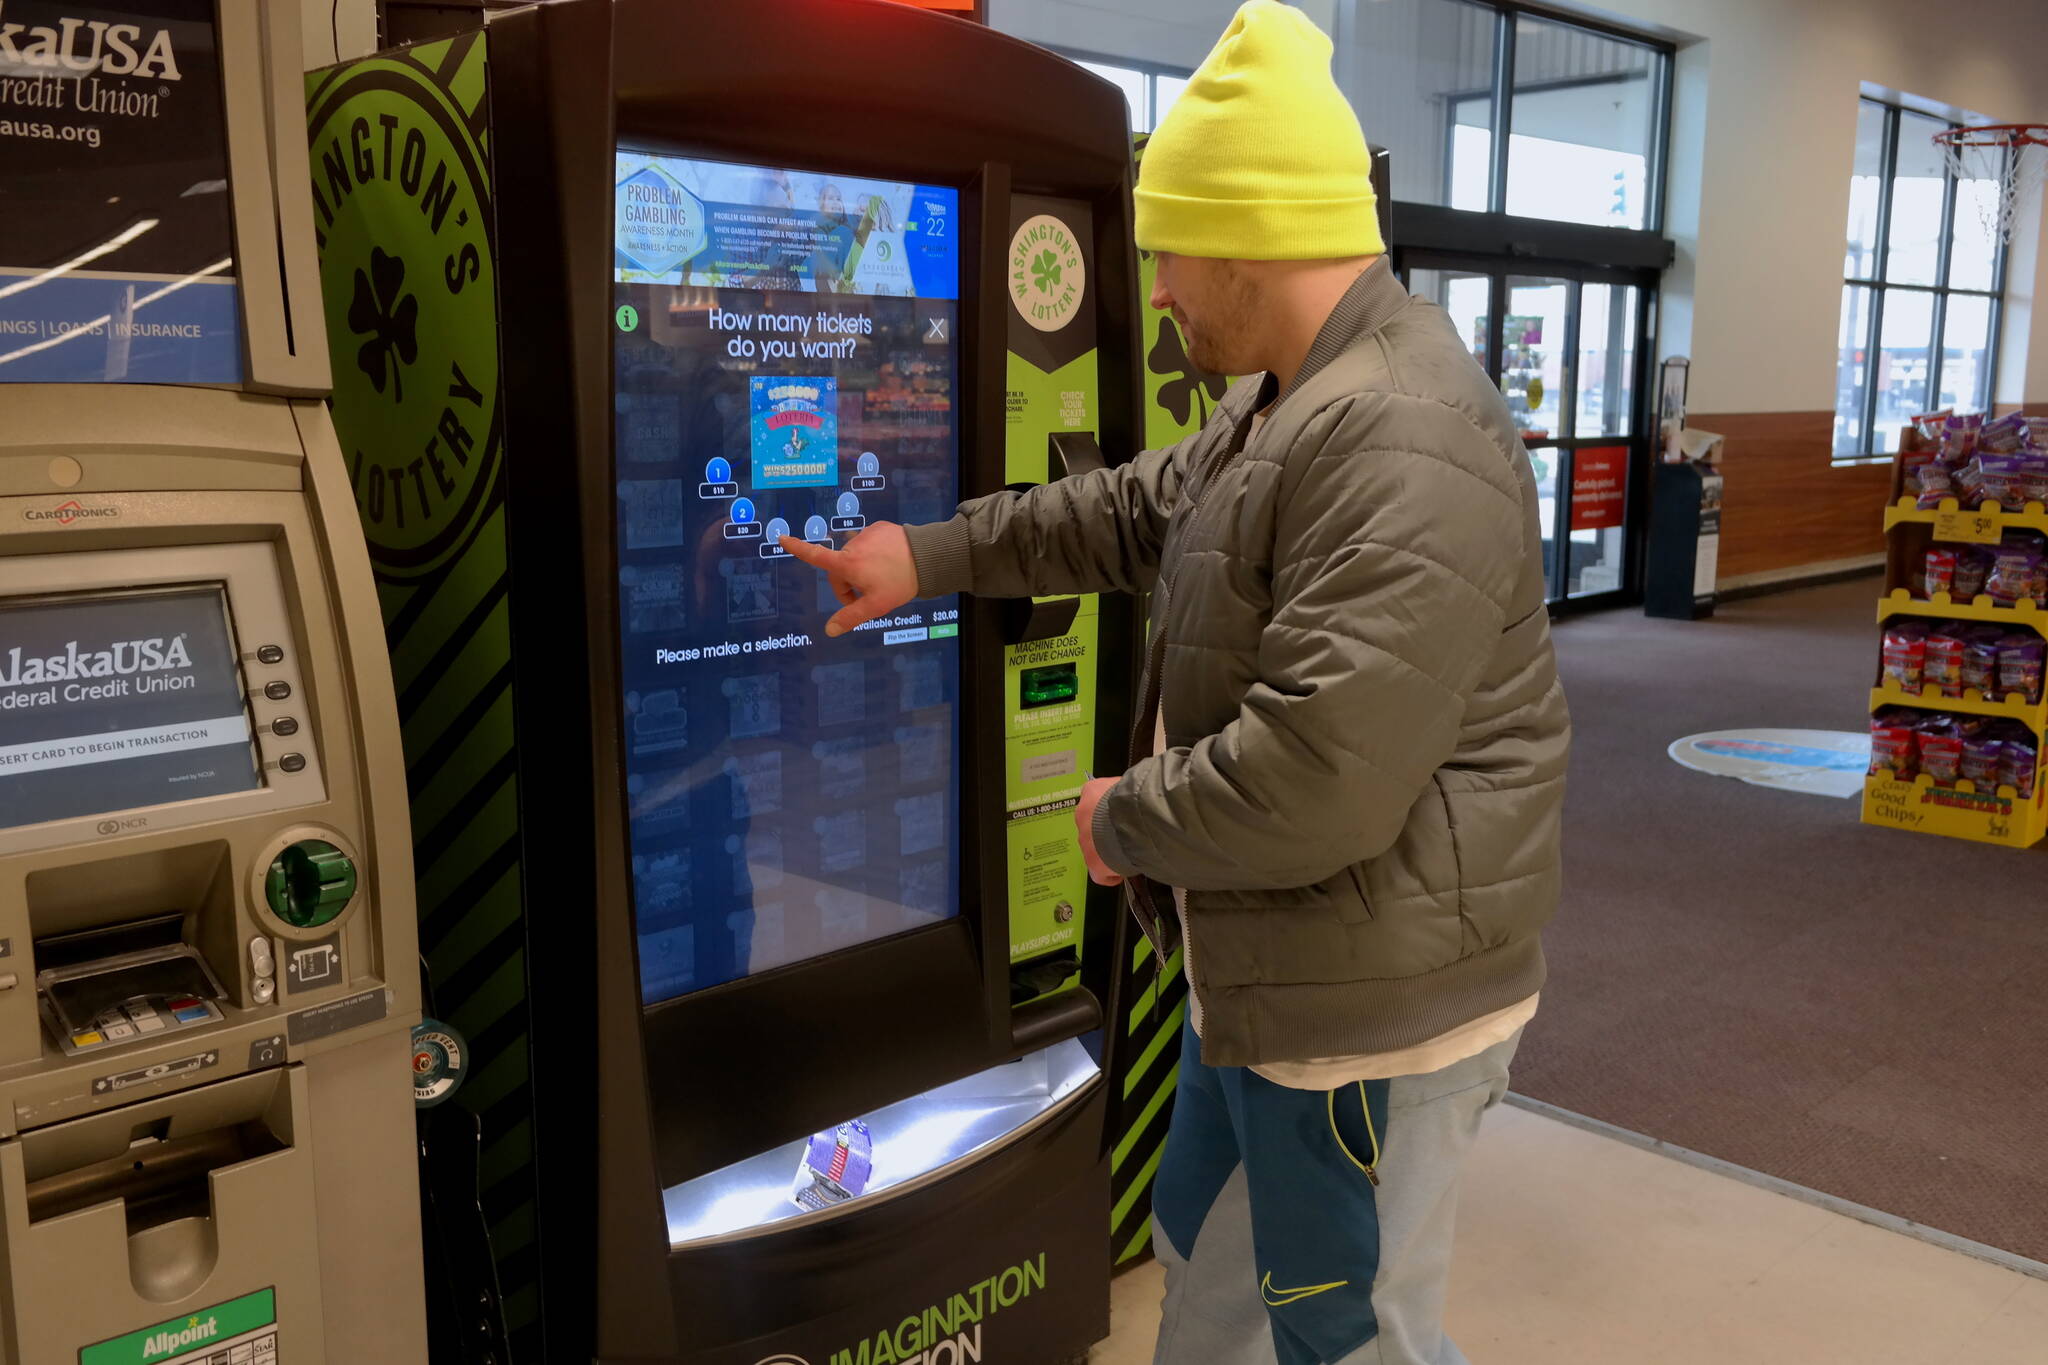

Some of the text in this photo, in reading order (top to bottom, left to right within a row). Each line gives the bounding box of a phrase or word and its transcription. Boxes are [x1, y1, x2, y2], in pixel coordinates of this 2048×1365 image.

[627, 184, 682, 206] PROBLEM
[312, 113, 480, 295] INGTON'S
[625, 205, 686, 225] GAMBLING
[621, 225, 694, 238] AWARENESS MONTH
[926, 217, 945, 237] 22
[1013, 224, 1077, 298] WASHINGTON'S
[1031, 283, 1077, 320] LOTTERY
[49, 321, 104, 338] LOANS
[115, 322, 202, 338] INSURANCE
[709, 308, 872, 337] How many tickets
[728, 335, 857, 362] do you want?
[1060, 391, 1085, 400] CHECK
[1059, 408, 1086, 418] TICKETS
[1063, 400, 1082, 409] YOUR
[715, 467, 721, 479] 1
[863, 462, 873, 472] 10
[713, 487, 725, 495] $10
[739, 508, 746, 519] 2
[845, 501, 851, 512] 5
[737, 526, 749, 535] $20
[775, 528, 781, 538] 3
[812, 525, 819, 536] 4
[894, 614, 922, 627] Credit:
[933, 609, 959, 622] $20.00
[656, 633, 813, 664] Please make a selection.
[1014, 636, 1079, 654] MACHINE DOES
[1009, 646, 1085, 666] NOT GIVE CHANGE
[0, 673, 195, 709] deral Credit Union
[1014, 713, 1038, 723] PLEASE
[32, 746, 66, 761] CARD
[69, 743, 86, 756] TO
[89, 738, 125, 754] BEGIN
[128, 729, 209, 749] TRANSACTION
[1871, 788, 1906, 805] Good
[1012, 811, 1026, 819] CALL
[121, 818, 148, 830] NCR
[1052, 927, 1074, 943] ONLY
[143, 1317, 217, 1359] Allpoint
[900, 1324, 981, 1365] ON
